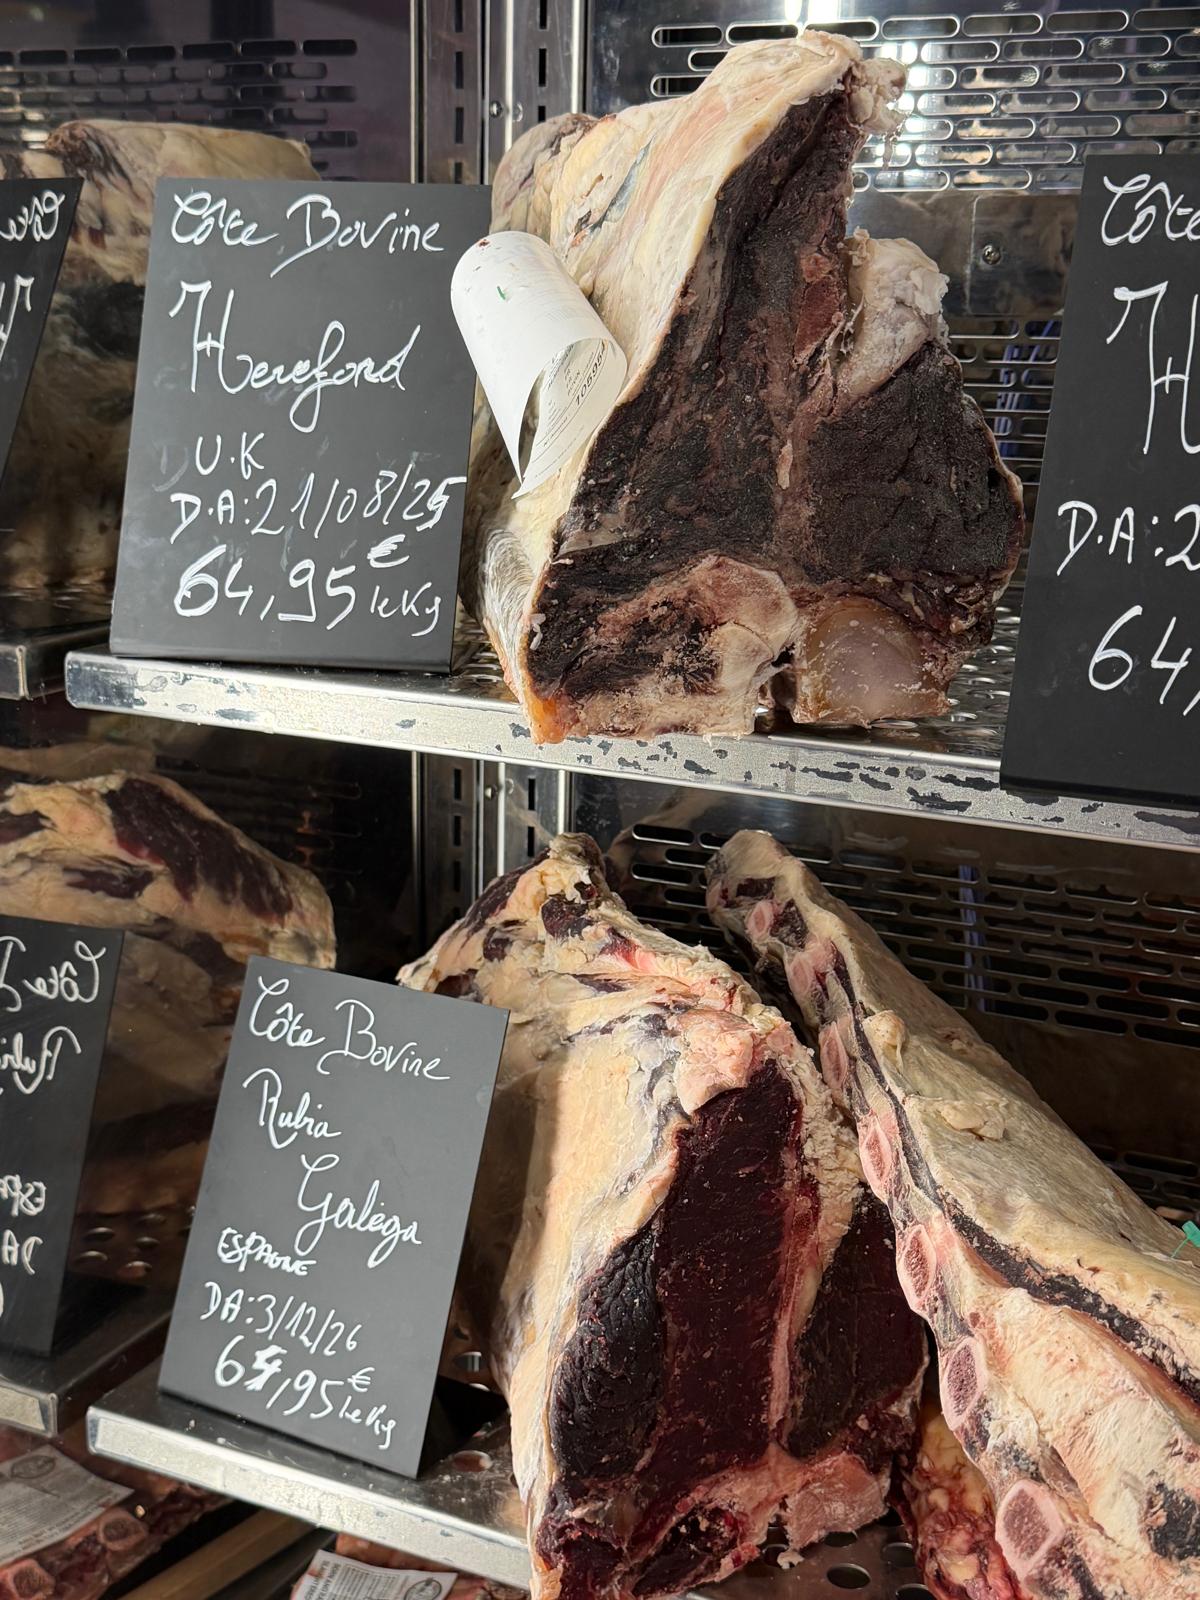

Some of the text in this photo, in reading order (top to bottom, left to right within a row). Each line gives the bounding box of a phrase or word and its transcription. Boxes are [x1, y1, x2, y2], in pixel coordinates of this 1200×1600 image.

[271, 193, 444, 278] Bovine
[169, 280, 421, 433] Hereford
[195, 433, 265, 480] U.K
[174, 544, 357, 631] 64,95
[247, 976, 451, 1081] Côte Bovine
[242, 1068, 342, 1149] Rubia
[216, 1226, 318, 1276] ESPAGNE
[346, 1366, 376, 1393] €
